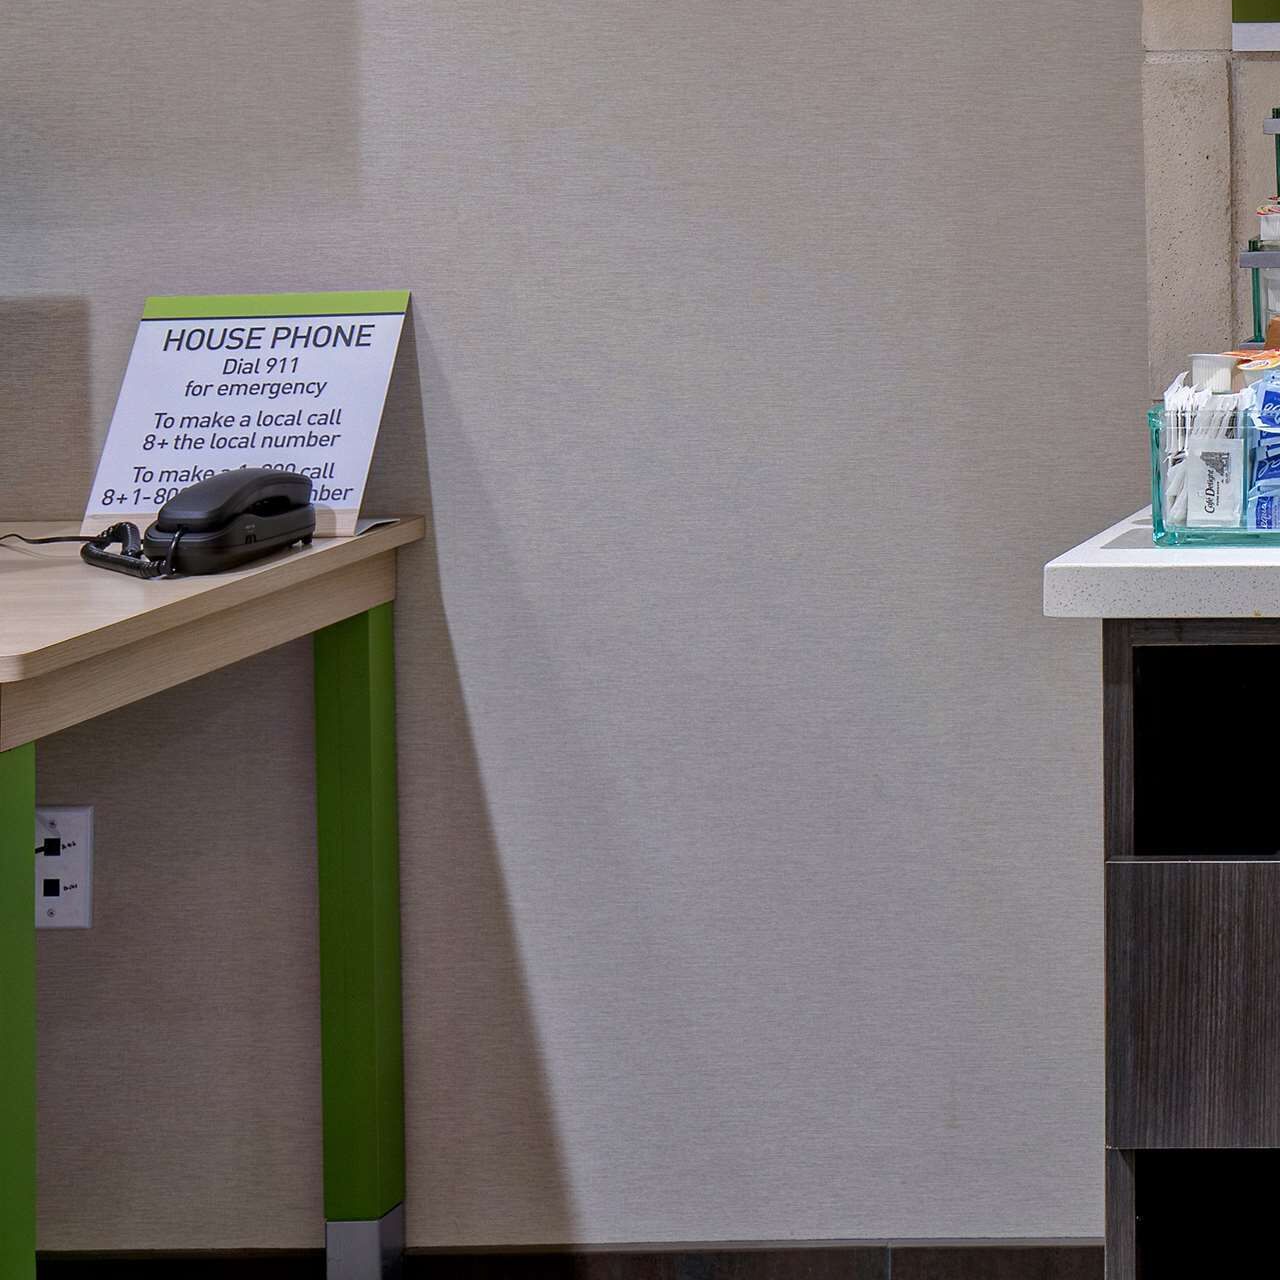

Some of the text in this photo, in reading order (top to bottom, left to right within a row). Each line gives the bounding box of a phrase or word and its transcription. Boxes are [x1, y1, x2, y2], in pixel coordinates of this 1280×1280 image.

[163, 324, 375, 351] HOUSE PHONE
[222, 357, 299, 375] Dial 911
[184, 380, 327, 398] for emergency
[154, 409, 343, 428] To make a local call
[142, 431, 341, 450] 8+ the local number
[133, 466, 154, 483] To
[159, 465, 214, 482] make
[300, 462, 335, 479] call
